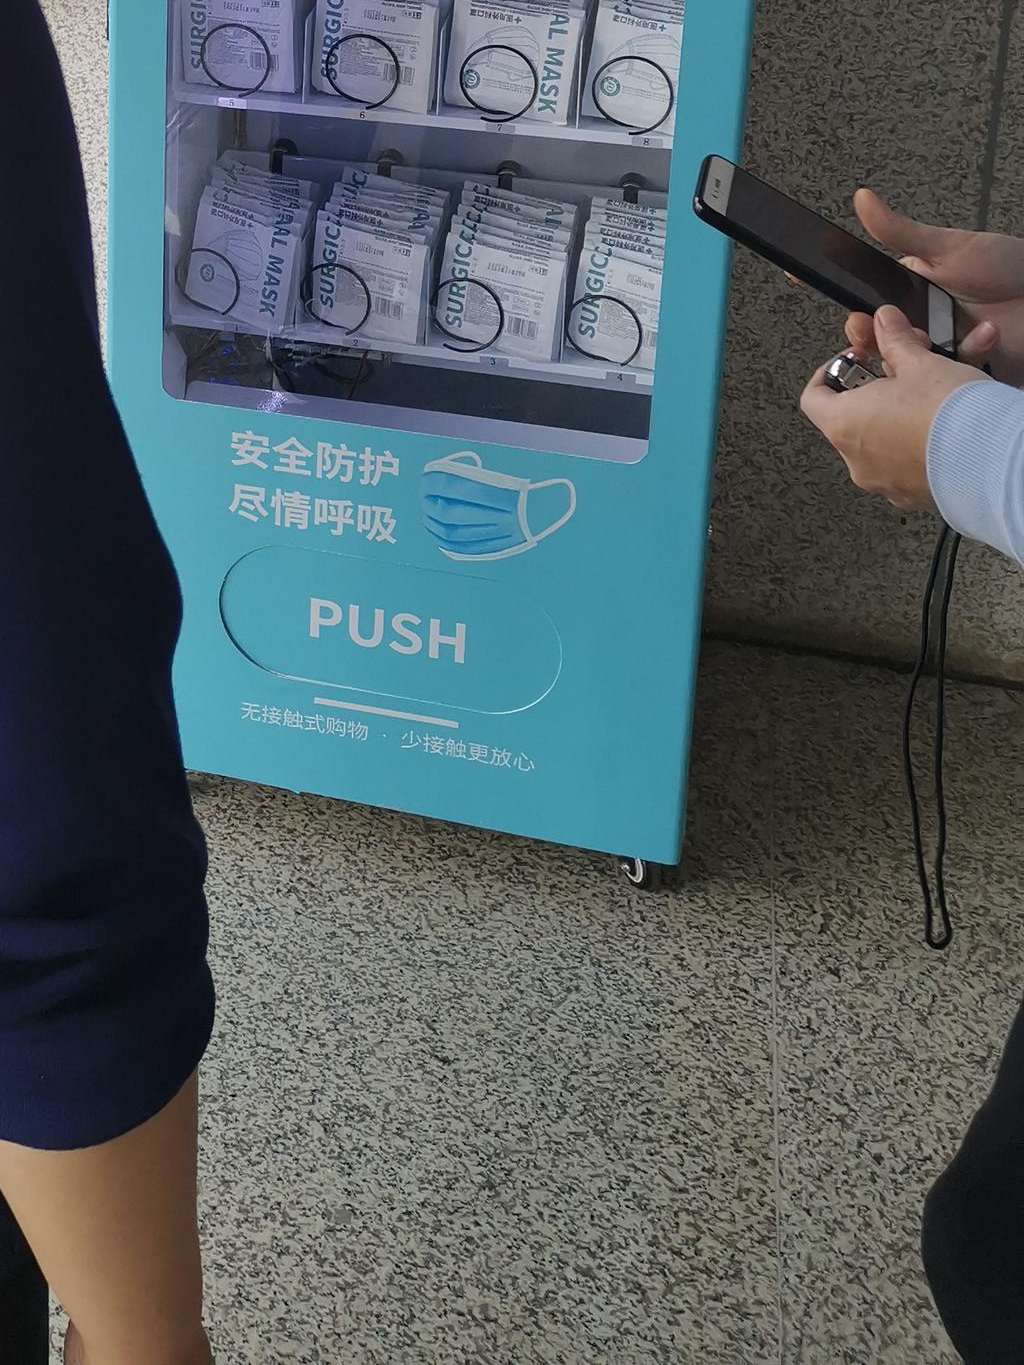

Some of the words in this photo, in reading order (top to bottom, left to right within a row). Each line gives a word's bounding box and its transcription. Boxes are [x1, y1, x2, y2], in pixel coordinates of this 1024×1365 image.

[537, 46, 566, 115] MASK
[359, 111, 366, 119] 6
[496, 123, 504, 132] 7
[642, 137, 650, 146] 8
[258, 256, 285, 318] MASK
[352, 338, 359, 347] 2
[490, 357, 496, 366] 3
[616, 373, 623, 382] 4
[230, 430, 400, 487] 安全防护
[228, 483, 397, 545] 尽情呼吸
[309, 597, 466, 664] PUSH
[240, 700, 369, 741] 无接触式购物
[401, 730, 535, 773] 少接触更放心
